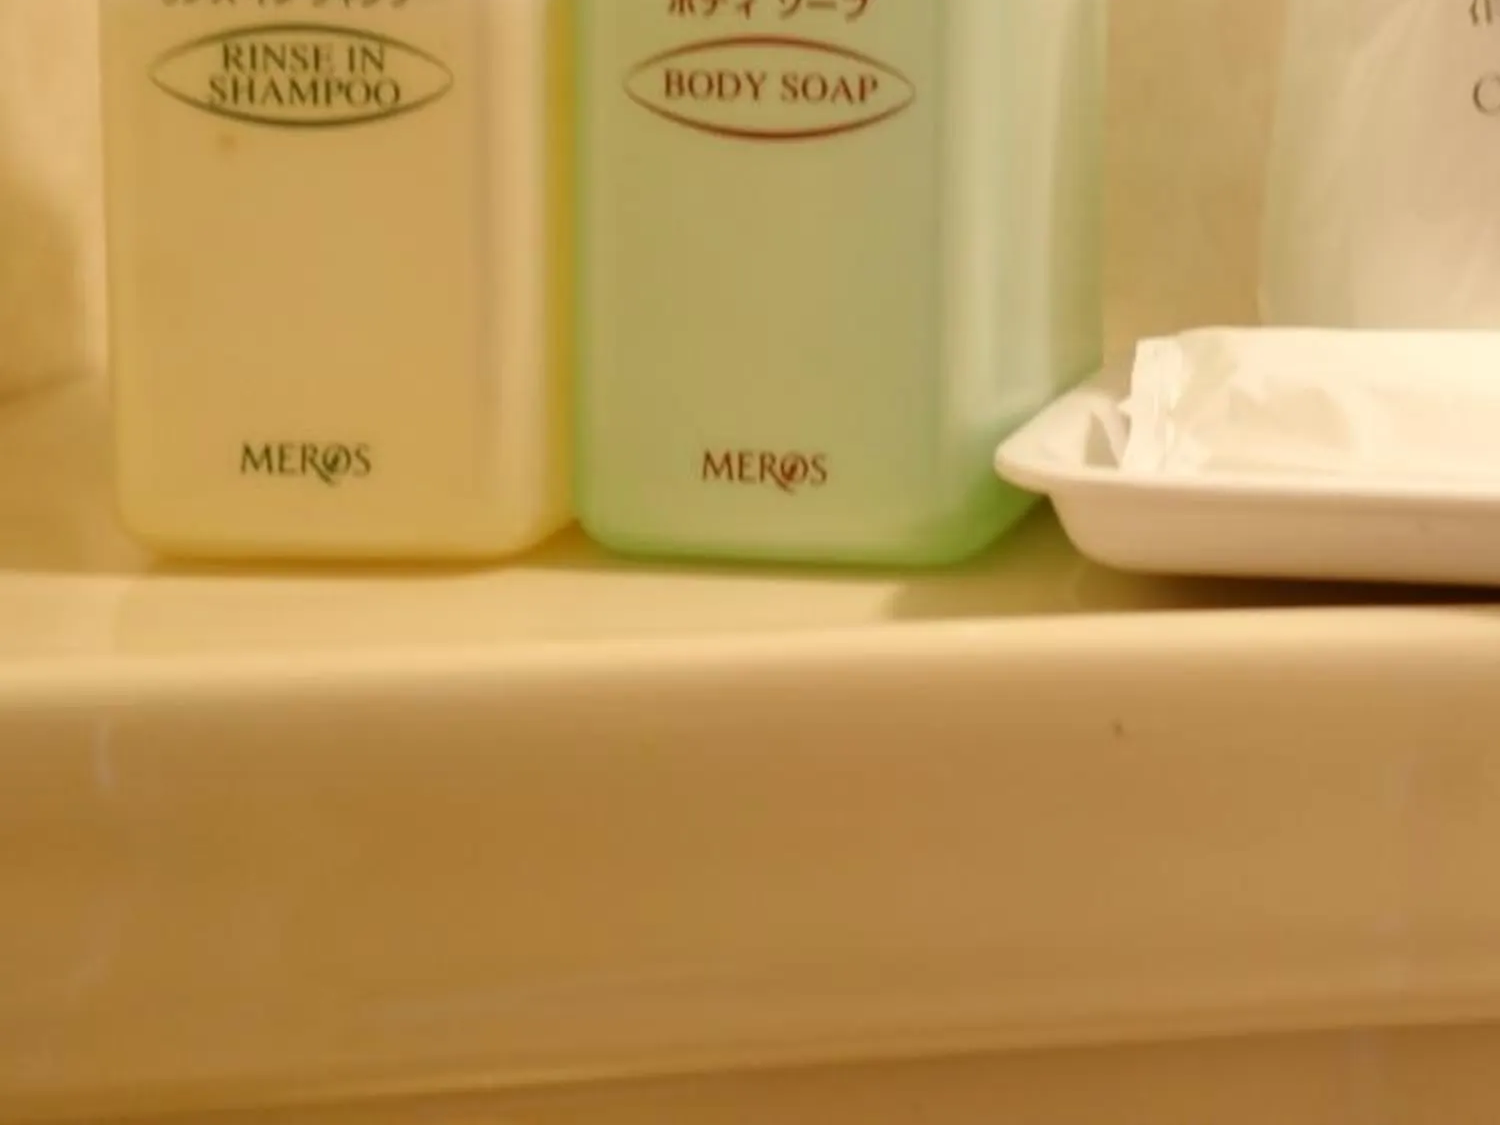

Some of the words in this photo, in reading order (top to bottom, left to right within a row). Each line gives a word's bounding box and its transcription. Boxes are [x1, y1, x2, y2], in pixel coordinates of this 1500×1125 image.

[221, 41, 336, 75] RINSE
[347, 42, 387, 74] IN
[207, 76, 401, 108] SHAMPOO
[663, 68, 768, 102] BODY
[780, 72, 880, 105] SOAP
[240, 441, 373, 487] MEROS
[701, 449, 829, 492] MEROS
